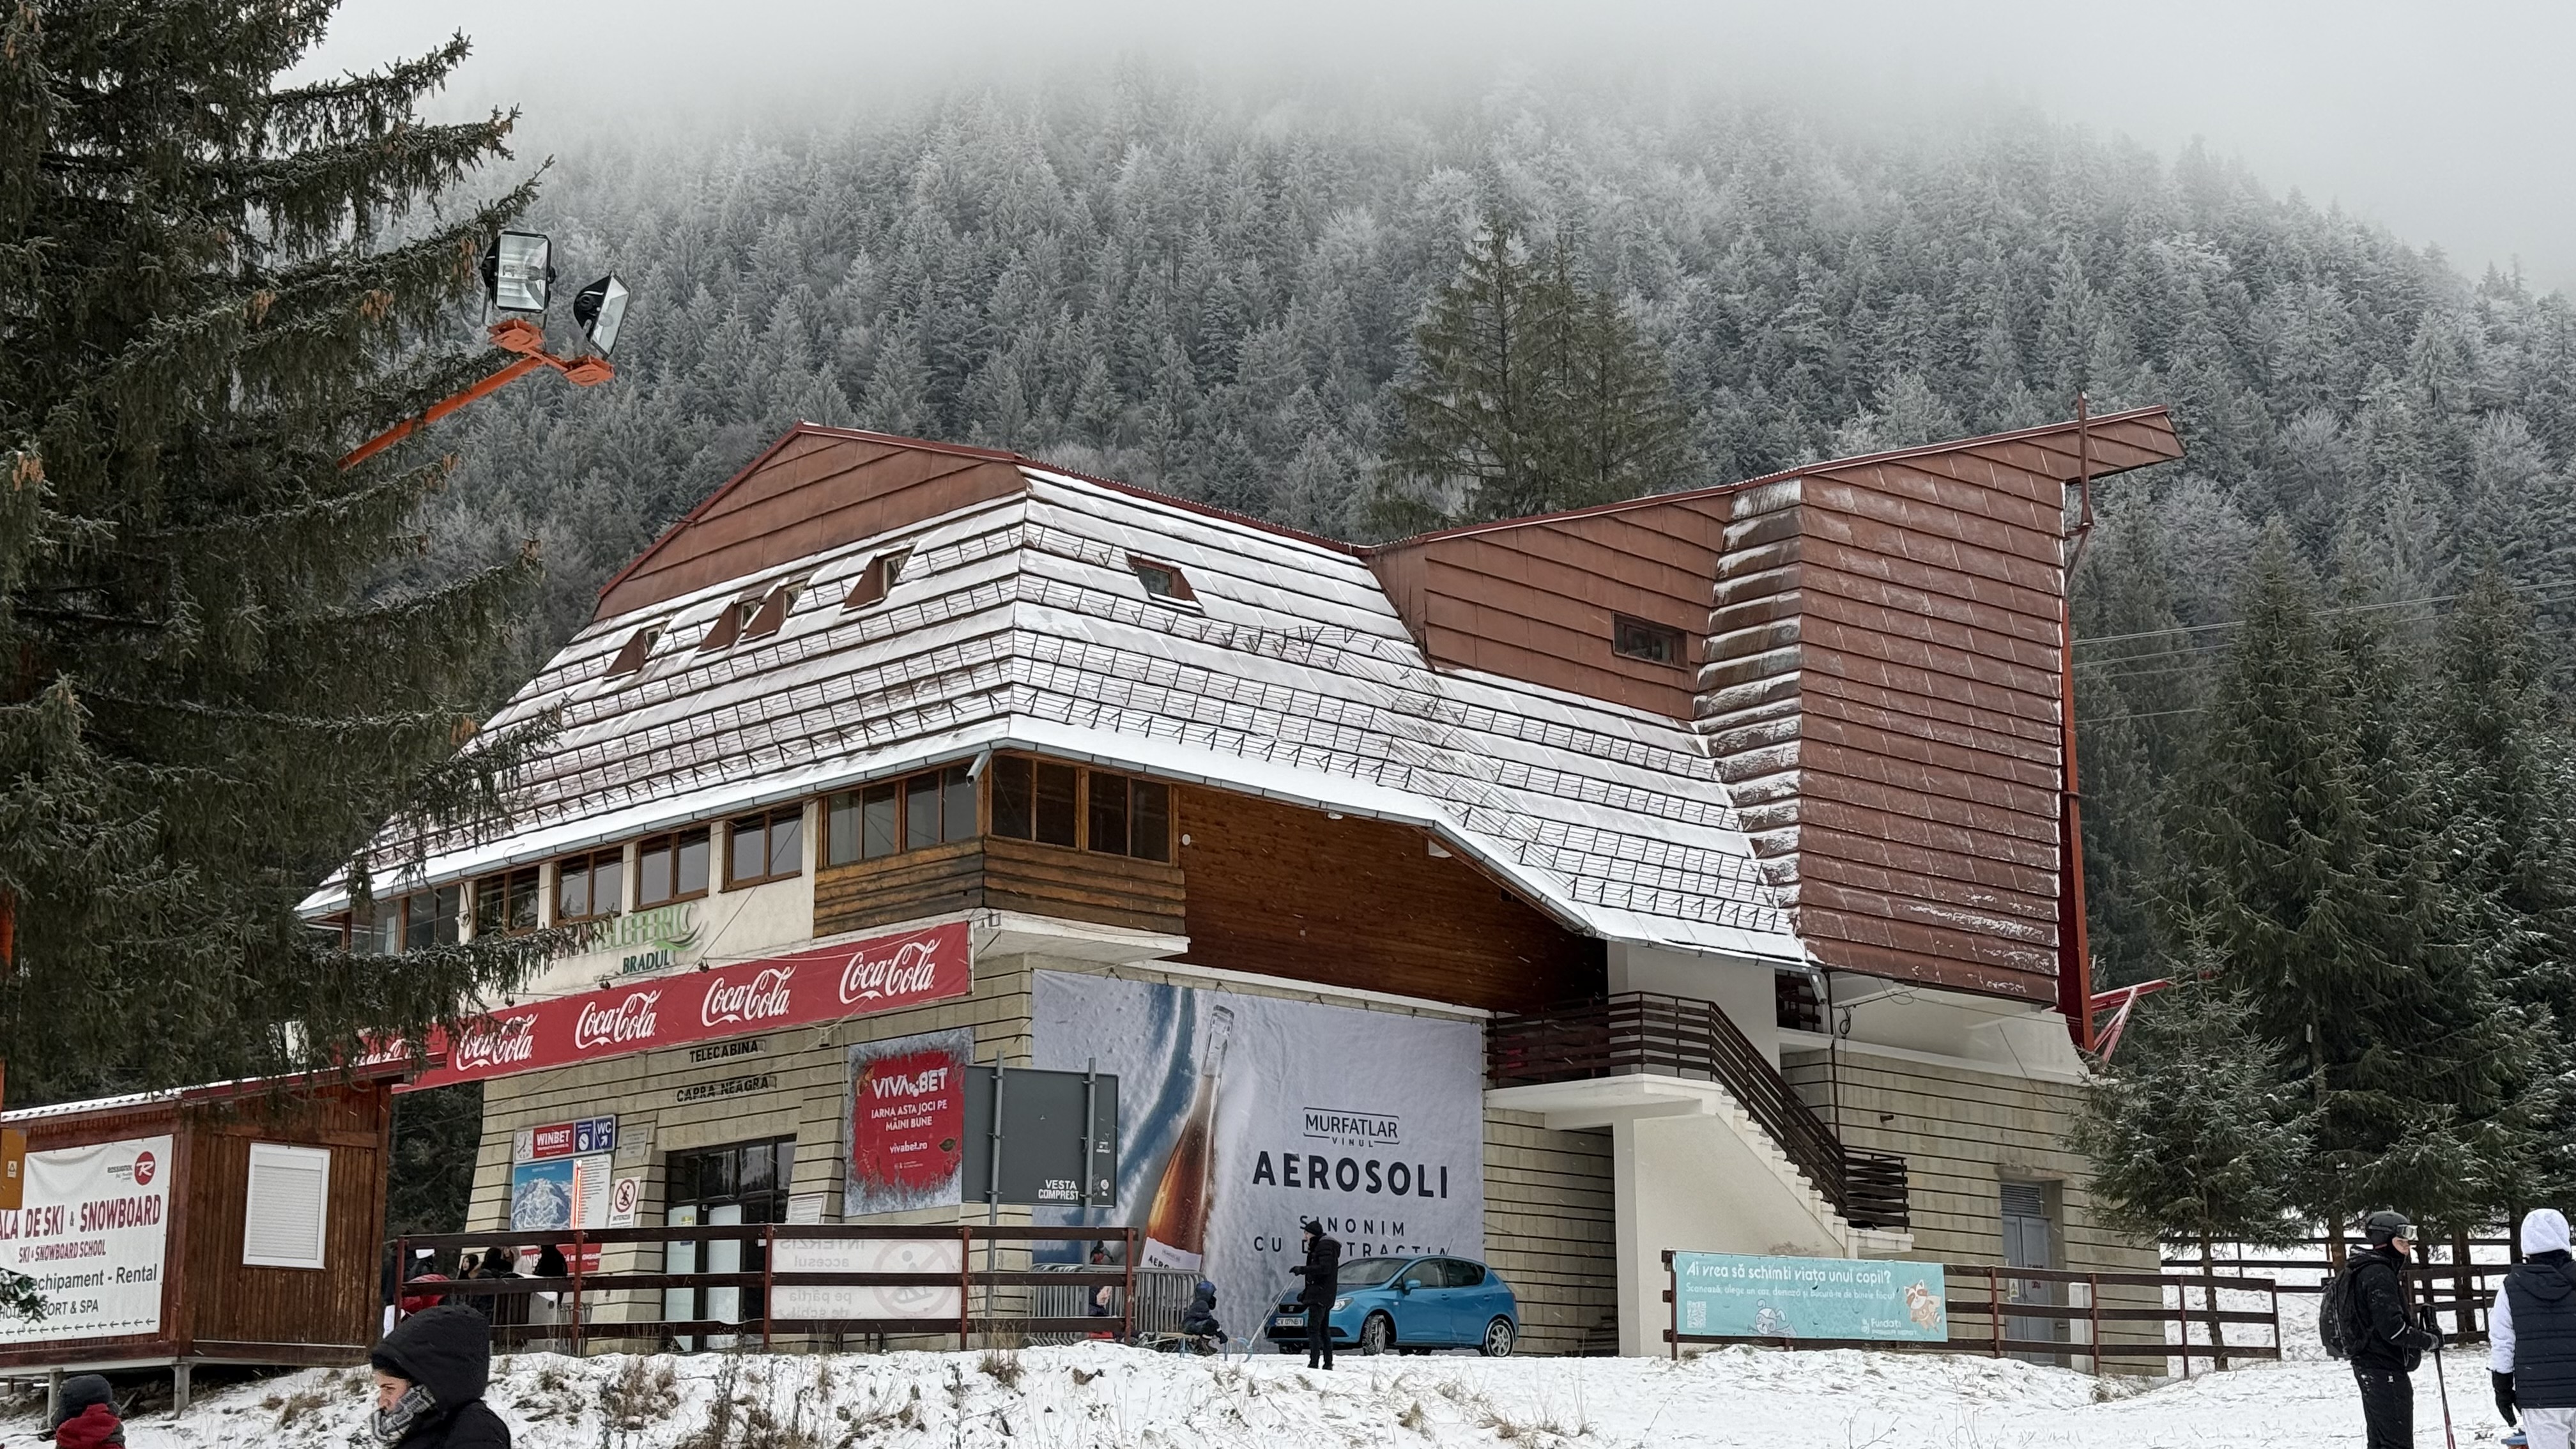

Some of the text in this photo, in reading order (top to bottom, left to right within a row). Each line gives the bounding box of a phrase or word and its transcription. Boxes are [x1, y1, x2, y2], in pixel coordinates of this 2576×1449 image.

[623, 949, 670, 974] BRADUL
[839, 937, 942, 1004] Coca-Cola
[702, 965, 797, 1027] Coca-Cola
[575, 989, 663, 1049] Coca-Cola
[689, 1040, 758, 1063] TELECABINA
[677, 1076, 769, 1102] CAPRA NEAGRA
[871, 1099, 947, 1119] IARNA ASTA JOCI PE
[597, 1121, 611, 1134] WC
[910, 1116, 932, 1128] BUNE
[1306, 1114, 1398, 1138] MURFATLAR
[537, 1130, 571, 1146] WINBET
[889, 1140, 928, 1154] vivabet.ro
[1331, 1137, 1374, 1147] VINUL
[1045, 1179, 1077, 1190] VESTA
[1253, 1151, 1447, 1199] AEROSOLI
[1038, 1189, 1079, 1200] COMPREST
[24, 1208, 42, 1238] DE
[43, 1205, 65, 1236] SKI
[70, 1211, 75, 1227] &
[79, 1194, 161, 1233] SNOWBOARD
[19, 1246, 30, 1263] SKI
[35, 1243, 78, 1262] SNOWBOARD
[79, 1239, 106, 1258] SCHOOL
[1254, 1236, 1282, 1252] CU
[116, 1263, 157, 1284] Rental
[1687, 1262, 1699, 1276] Ai
[1702, 1266, 1728, 1277] vrea
[1731, 1263, 1745, 1278] să
[1856, 1270, 1891, 1286] copil?
[36, 1301, 68, 1317] PORT
[70, 1301, 77, 1314] &
[80, 1300, 99, 1313] SPA
